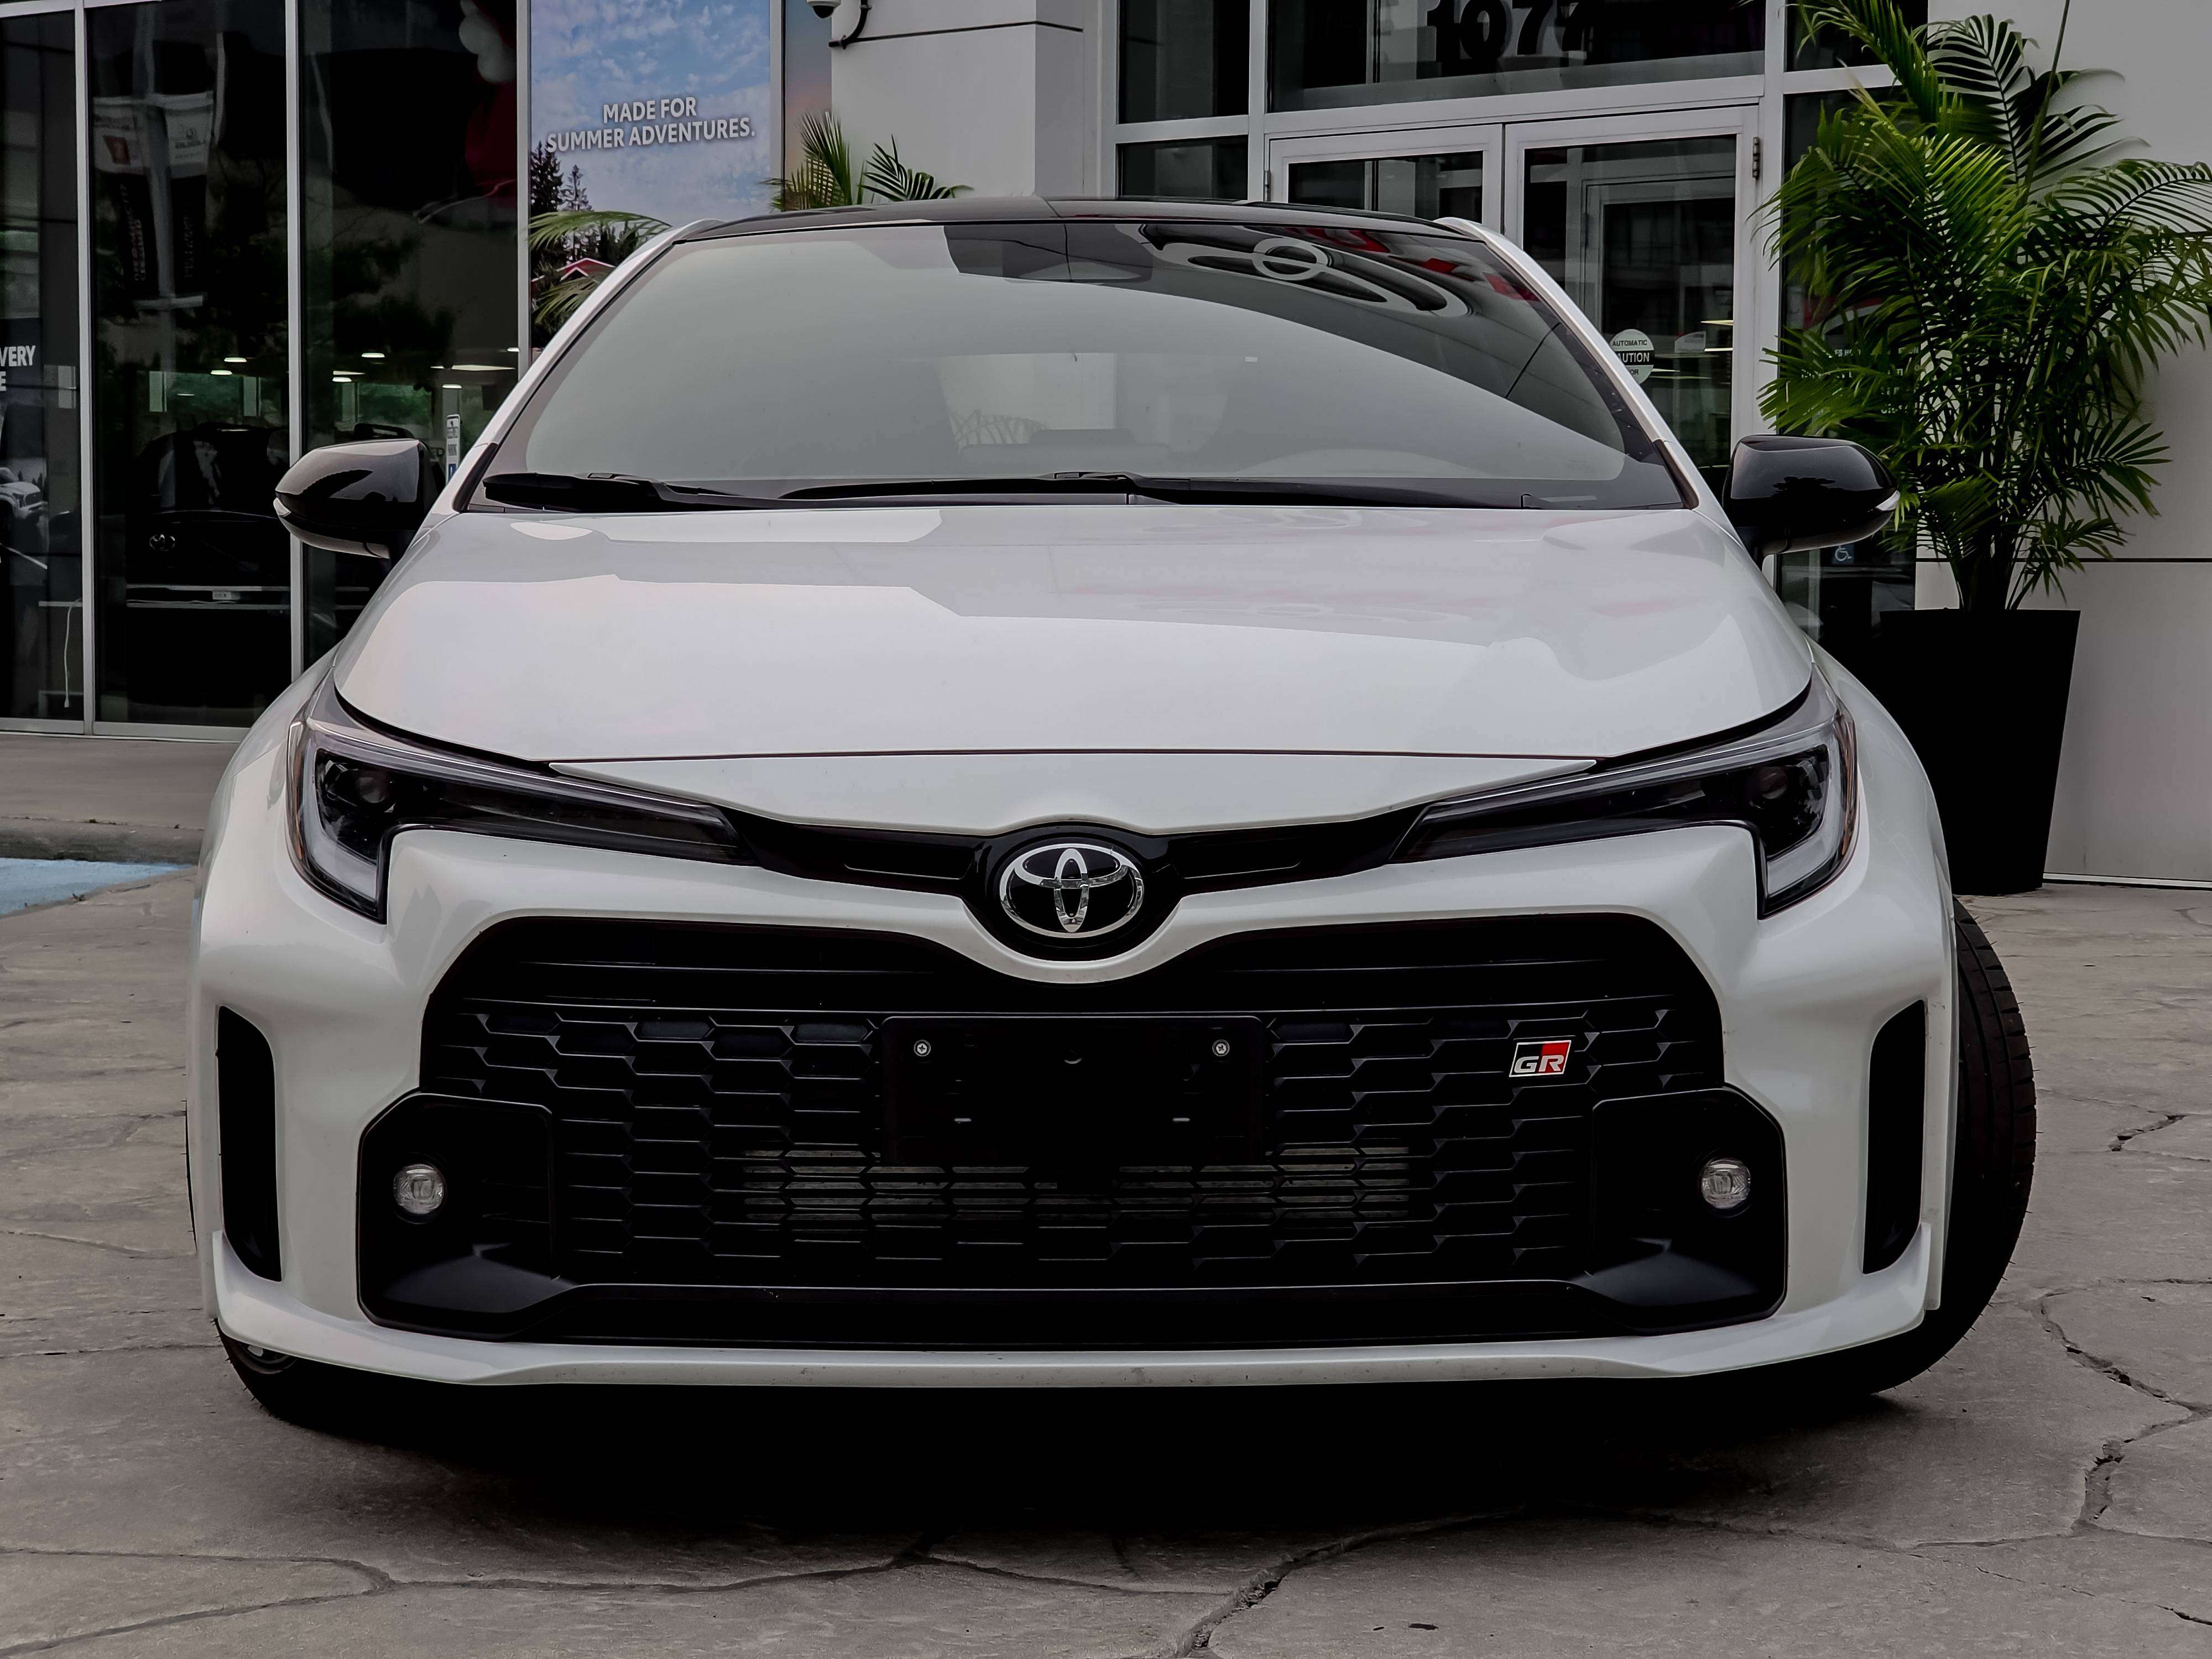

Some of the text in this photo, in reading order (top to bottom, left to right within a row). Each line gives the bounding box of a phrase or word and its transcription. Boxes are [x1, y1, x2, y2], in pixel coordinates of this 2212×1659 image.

[603, 97, 696, 123] MADE FOR
[547, 117, 755, 153] SUMMER ADVENTURES.
[1618, 352, 1650, 363] AUTION
[1514, 1055, 1564, 1073] GR
